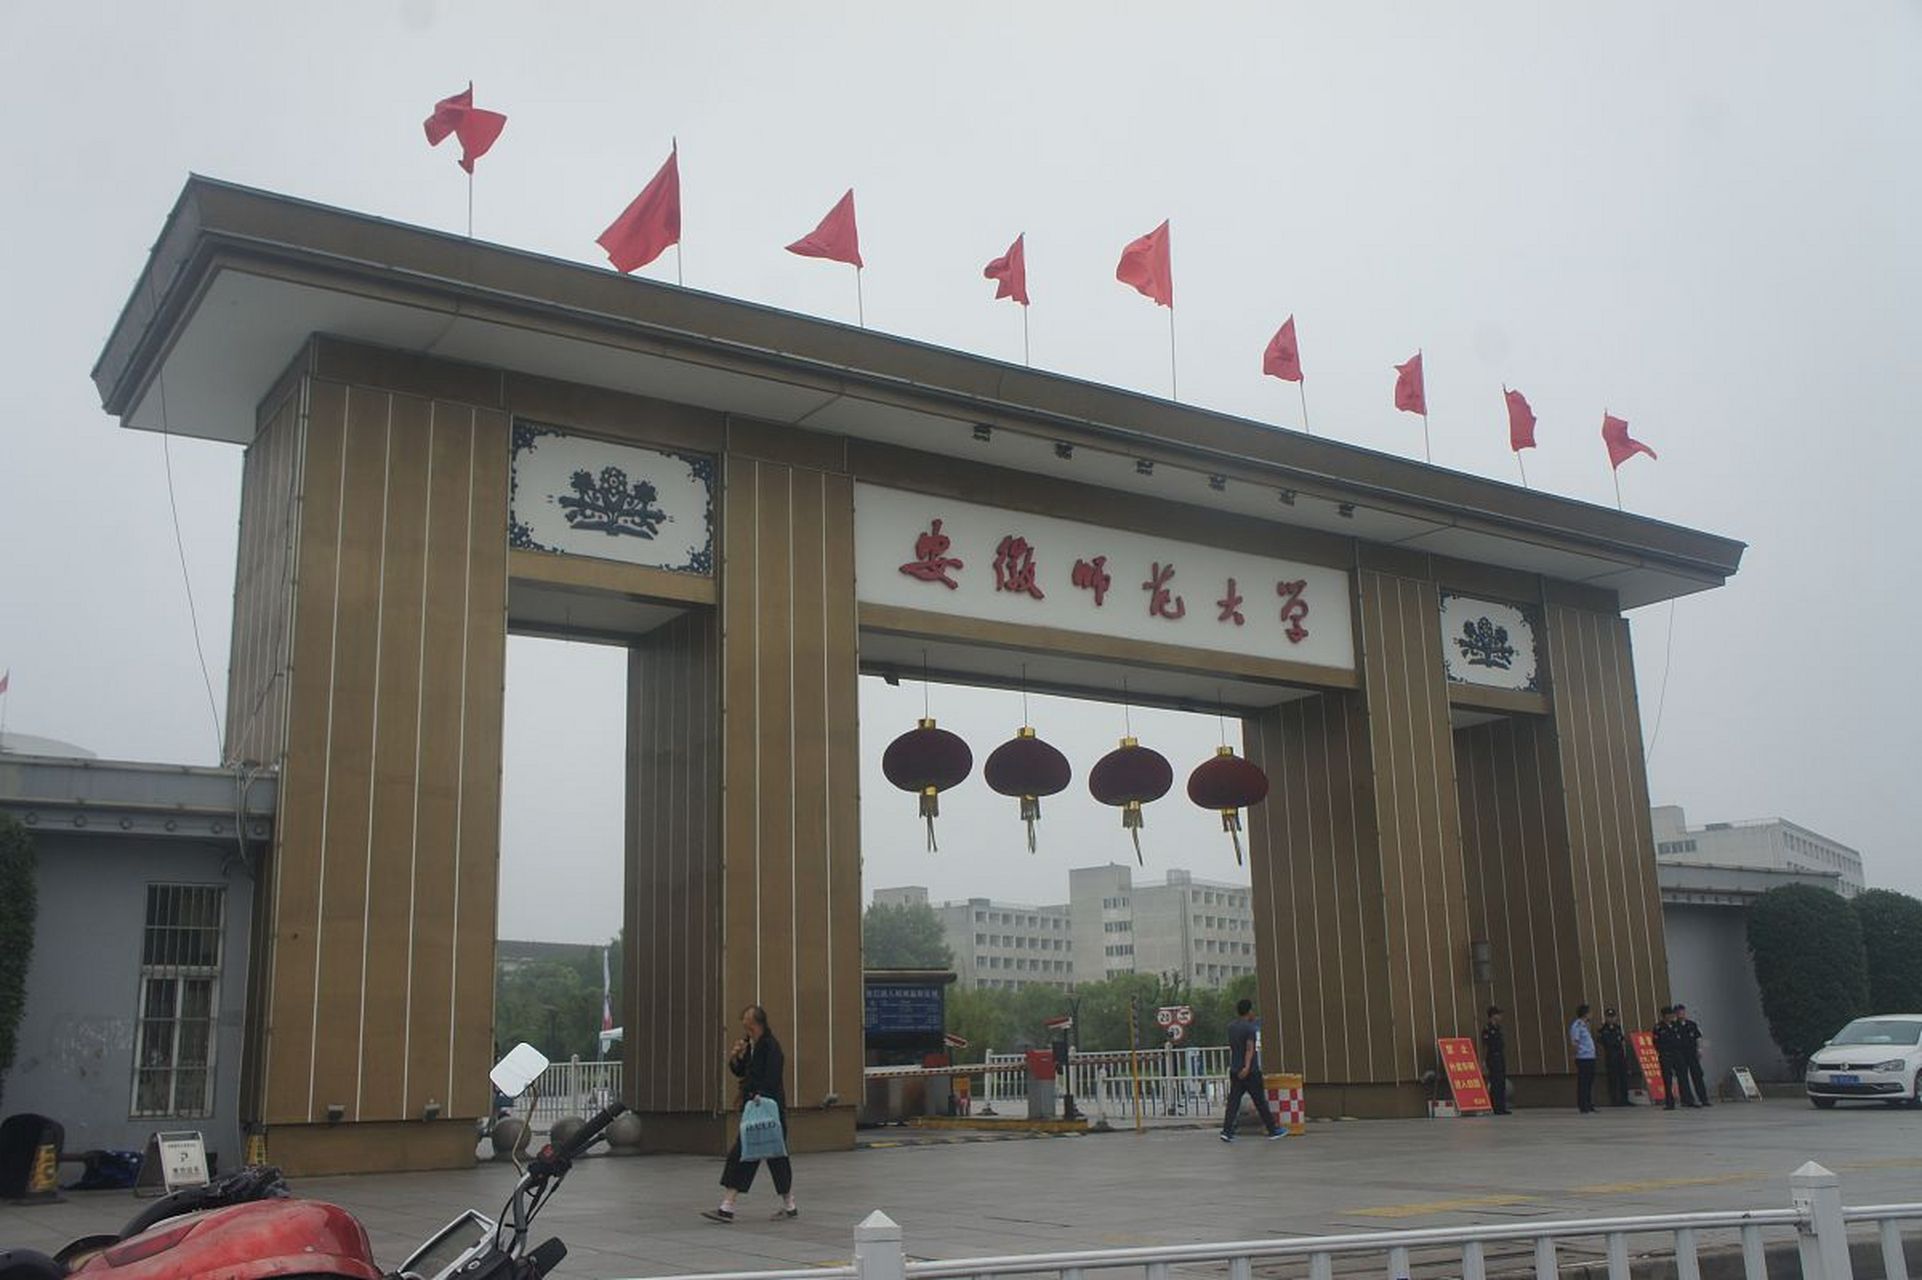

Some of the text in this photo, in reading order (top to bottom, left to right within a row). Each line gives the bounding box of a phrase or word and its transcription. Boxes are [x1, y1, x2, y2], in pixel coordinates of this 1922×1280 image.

[899, 519, 1309, 644] 安徽师范大学
